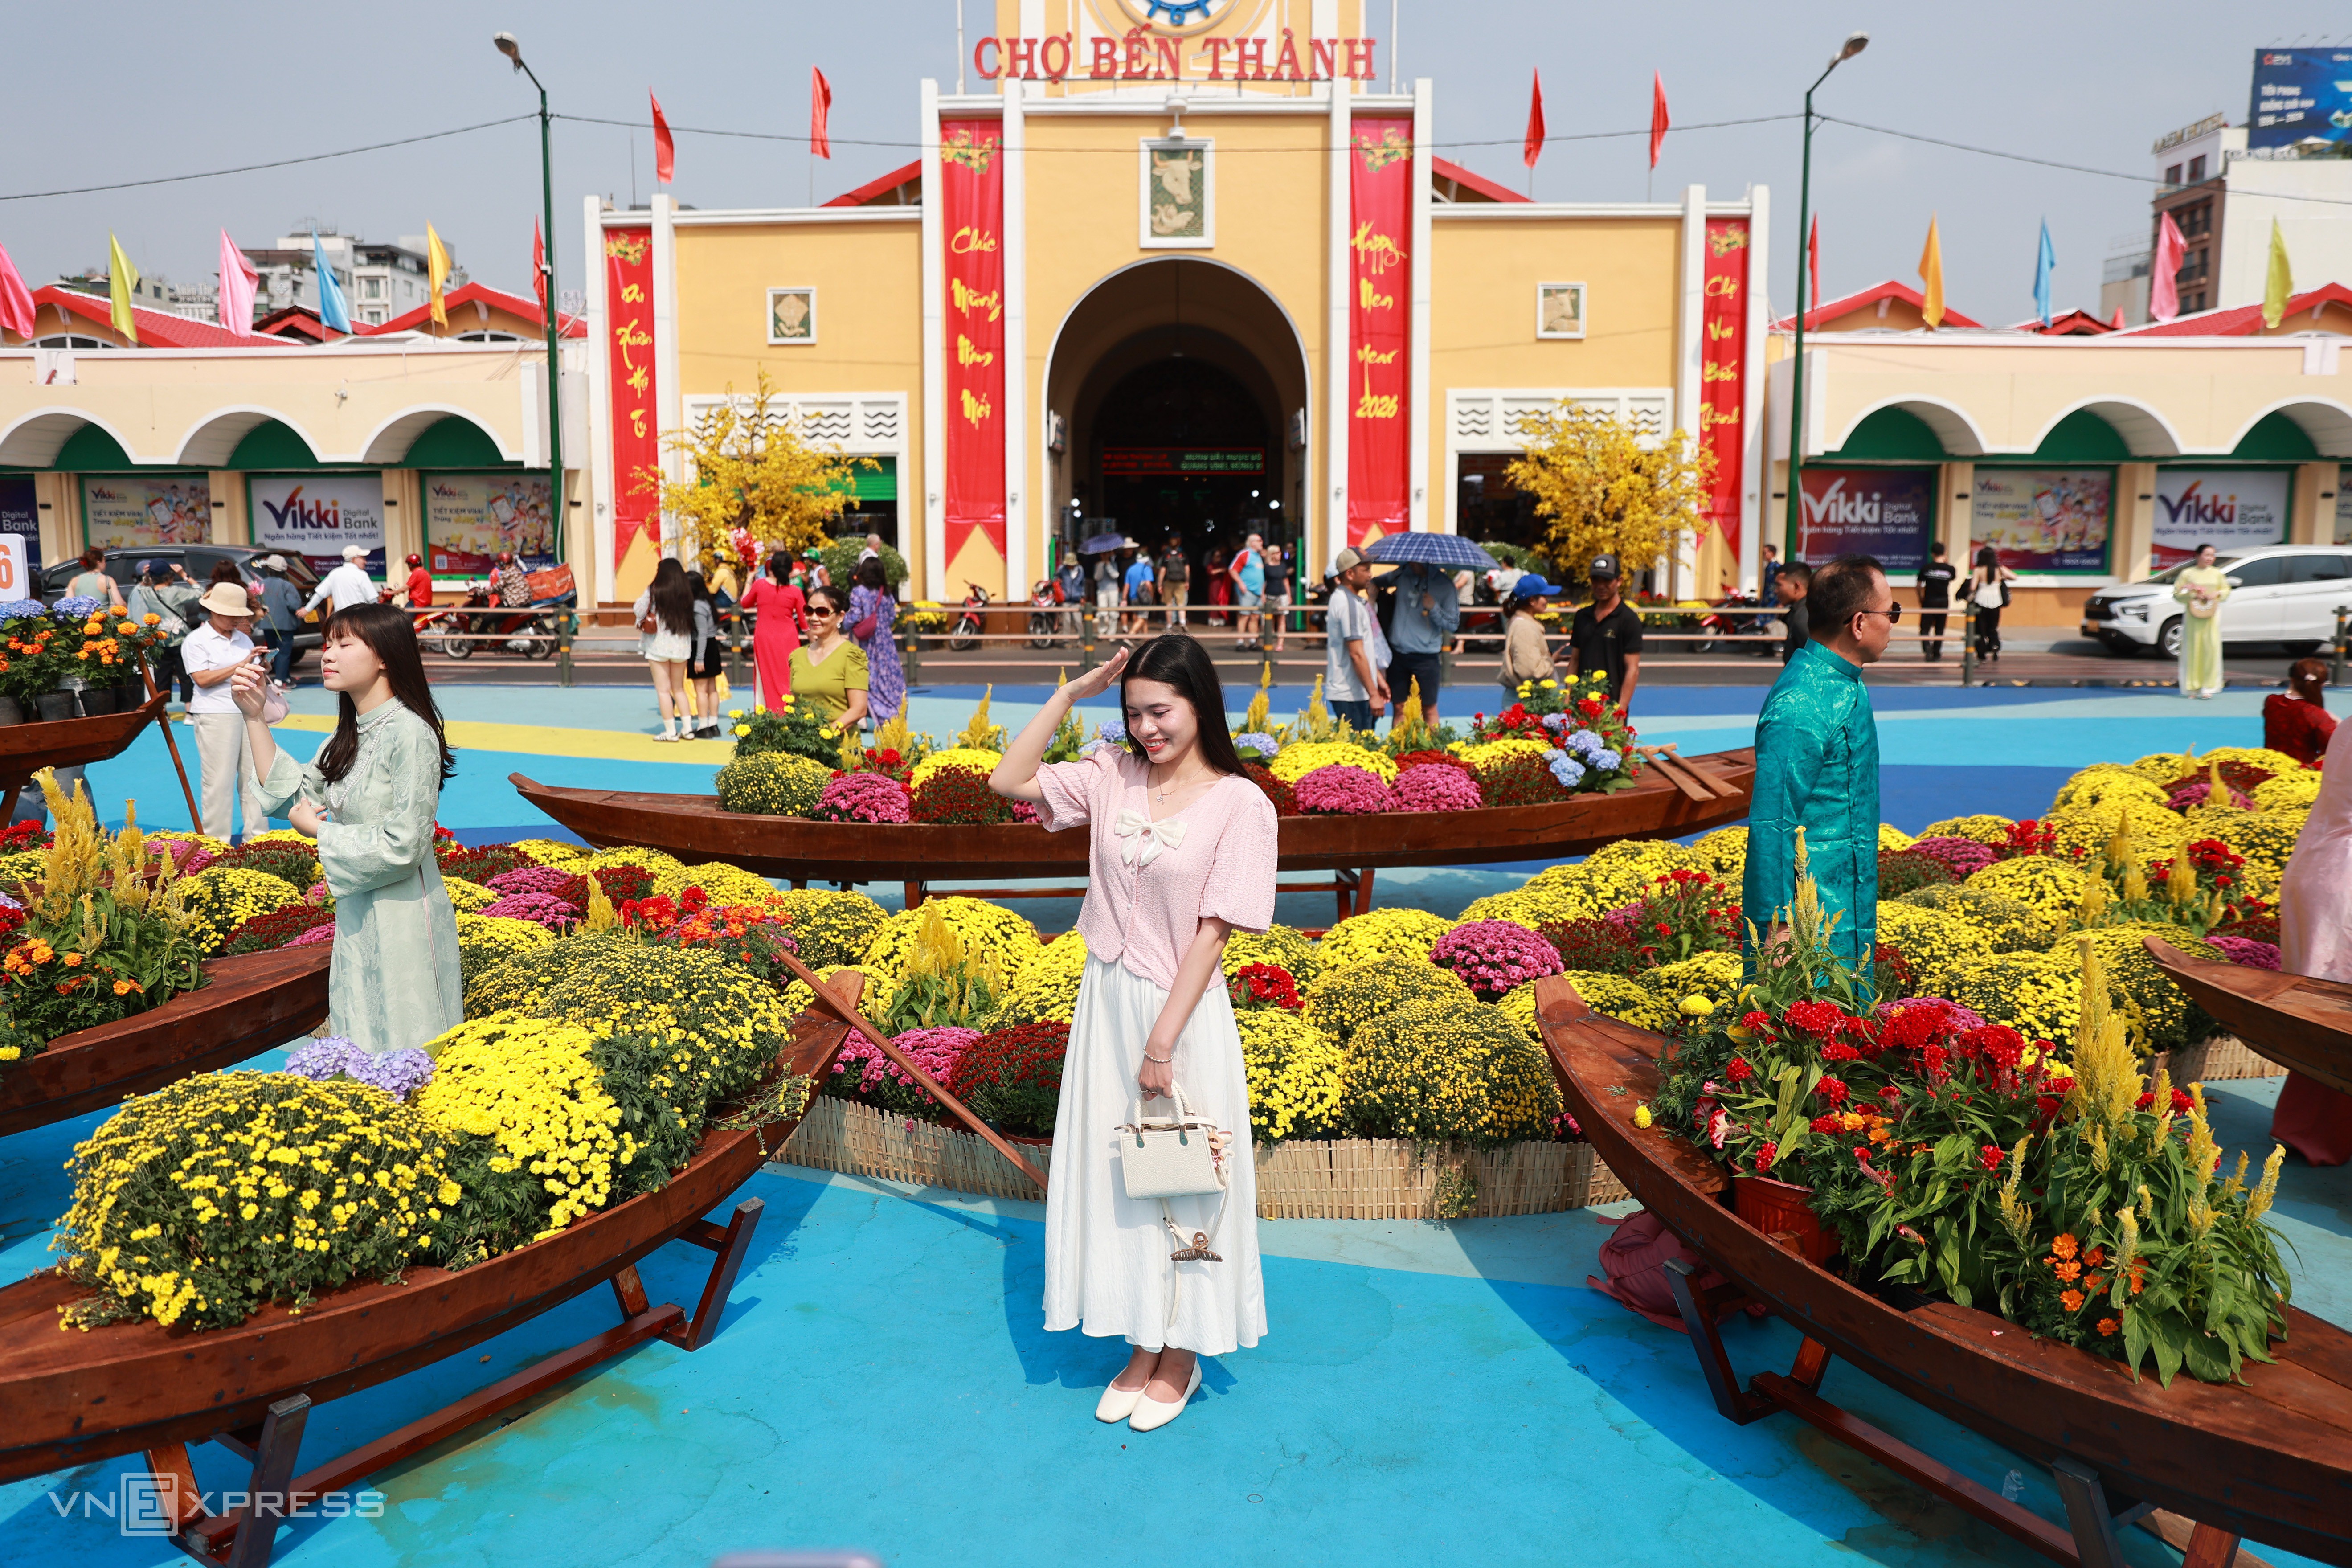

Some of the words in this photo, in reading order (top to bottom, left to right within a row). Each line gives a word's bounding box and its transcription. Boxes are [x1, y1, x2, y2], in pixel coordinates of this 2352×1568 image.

[974, 31, 1072, 84] CHỢ
[1090, 23, 1183, 78] BẾN
[1203, 27, 1377, 79] THÀNH
[951, 226, 997, 254] Chúc
[1350, 220, 1408, 275] Happy
[1356, 395, 1399, 418] 2026
[263, 485, 339, 529] Vikki
[1803, 476, 1882, 523] Vikki
[2158, 479, 2237, 524] Vikki
[2, 512, 28, 520] Digital
[3, 520, 37, 532] Bank
[344, 518, 377, 529] Bank
[1883, 512, 1920, 524] Bank
[2238, 513, 2274, 524] Bank
[265, 533, 285, 541] Ngân
[286, 533, 306, 541] hàng
